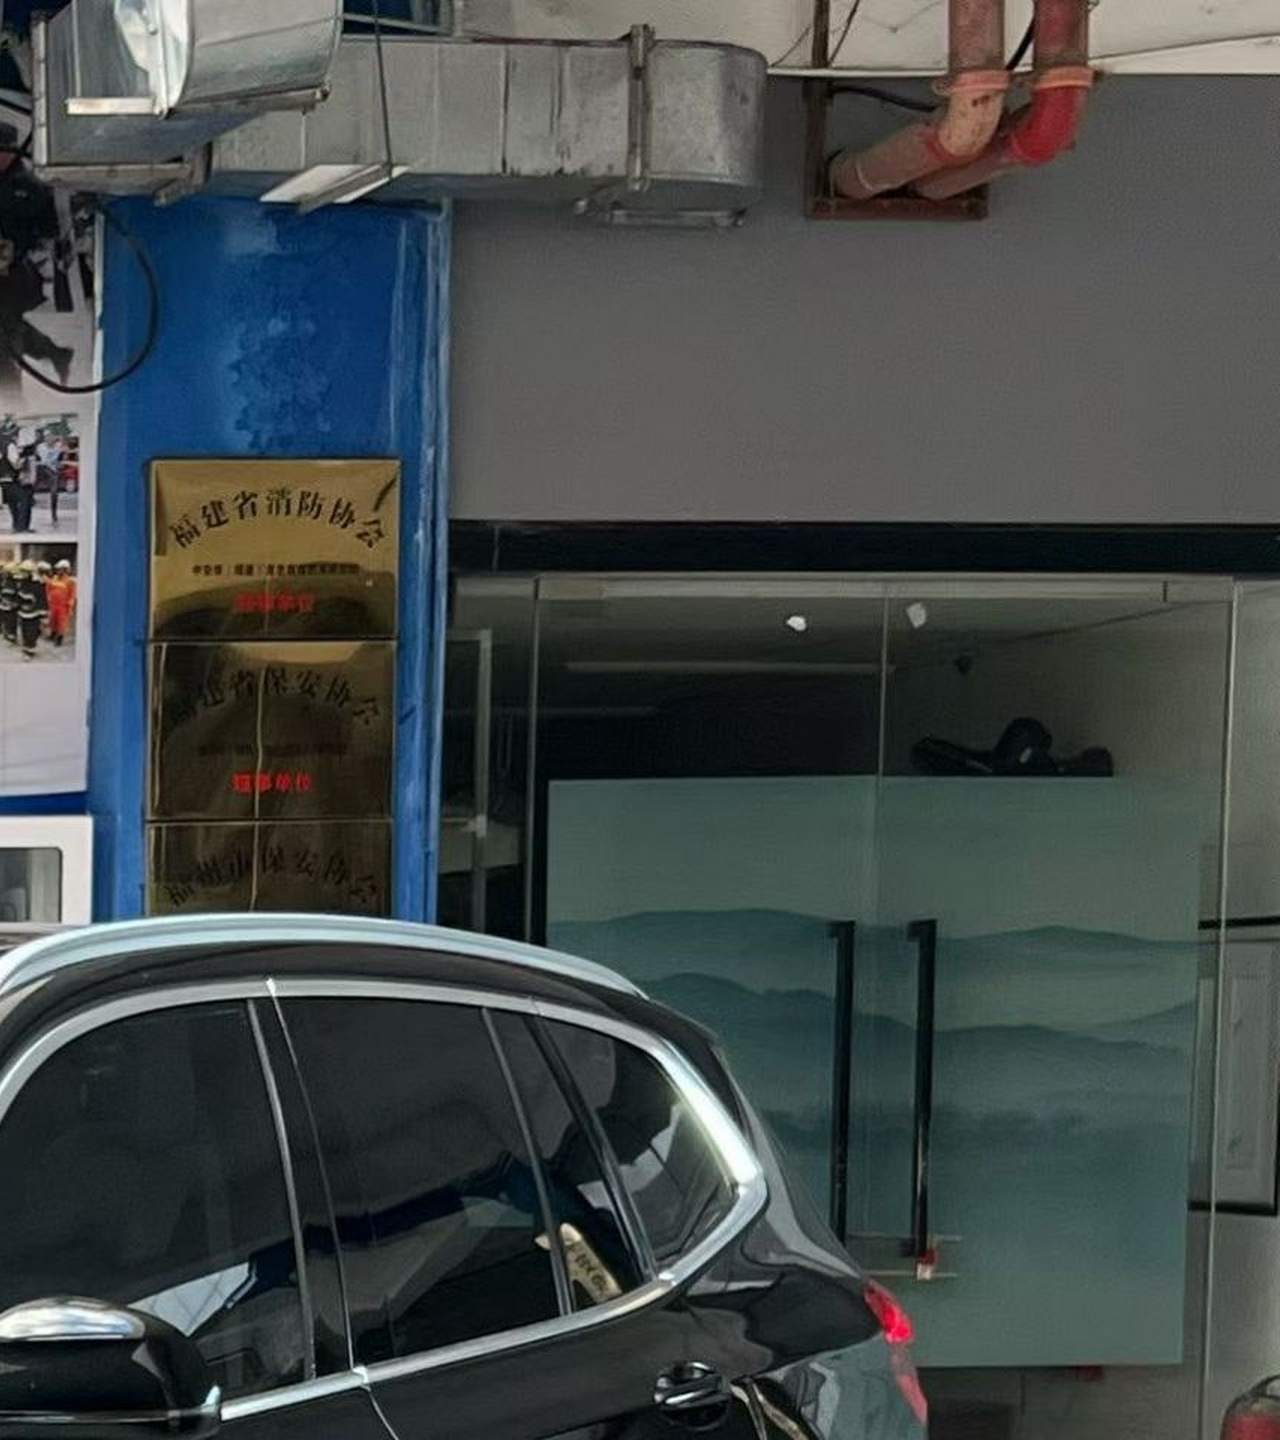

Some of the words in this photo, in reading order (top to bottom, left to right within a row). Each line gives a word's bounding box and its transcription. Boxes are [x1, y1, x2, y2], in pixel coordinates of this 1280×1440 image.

[169, 486, 385, 548] 福建省消防协会
